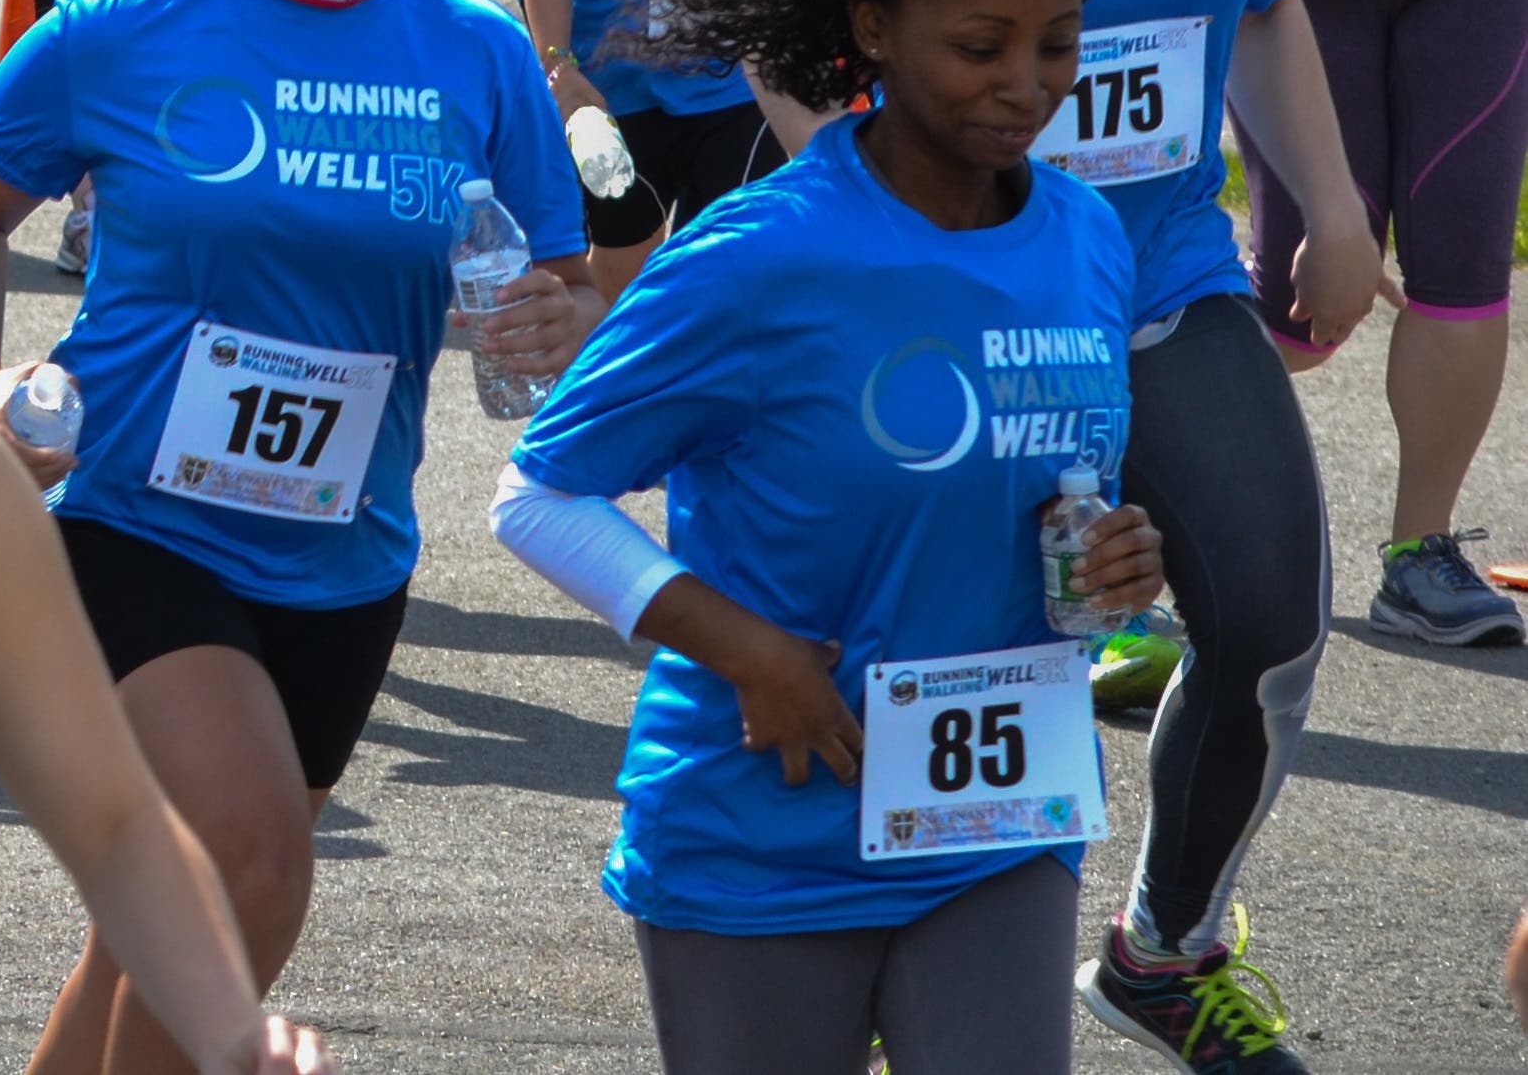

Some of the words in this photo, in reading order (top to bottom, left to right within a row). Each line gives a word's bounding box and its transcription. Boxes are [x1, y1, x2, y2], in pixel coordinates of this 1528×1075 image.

[1120, 34, 1159, 57] WELL
[275, 79, 441, 120] RUNNING
[1066, 62, 1164, 142] 175
[275, 114, 442, 155] WALKING
[276, 148, 387, 191] WELL
[389, 153, 466, 225] 5K
[243, 344, 304, 367] RUNNING
[304, 362, 349, 383] WELL
[982, 327, 1112, 368] RUNNING
[240, 357, 305, 381] WALKING
[986, 369, 1125, 410] WALKING
[226, 383, 344, 469] 157
[990, 411, 1078, 459] WELL
[921, 665, 986, 685] RUNNING
[987, 663, 1036, 687] WELL
[921, 680, 988, 699] WALKING
[928, 701, 1026, 793] 85
